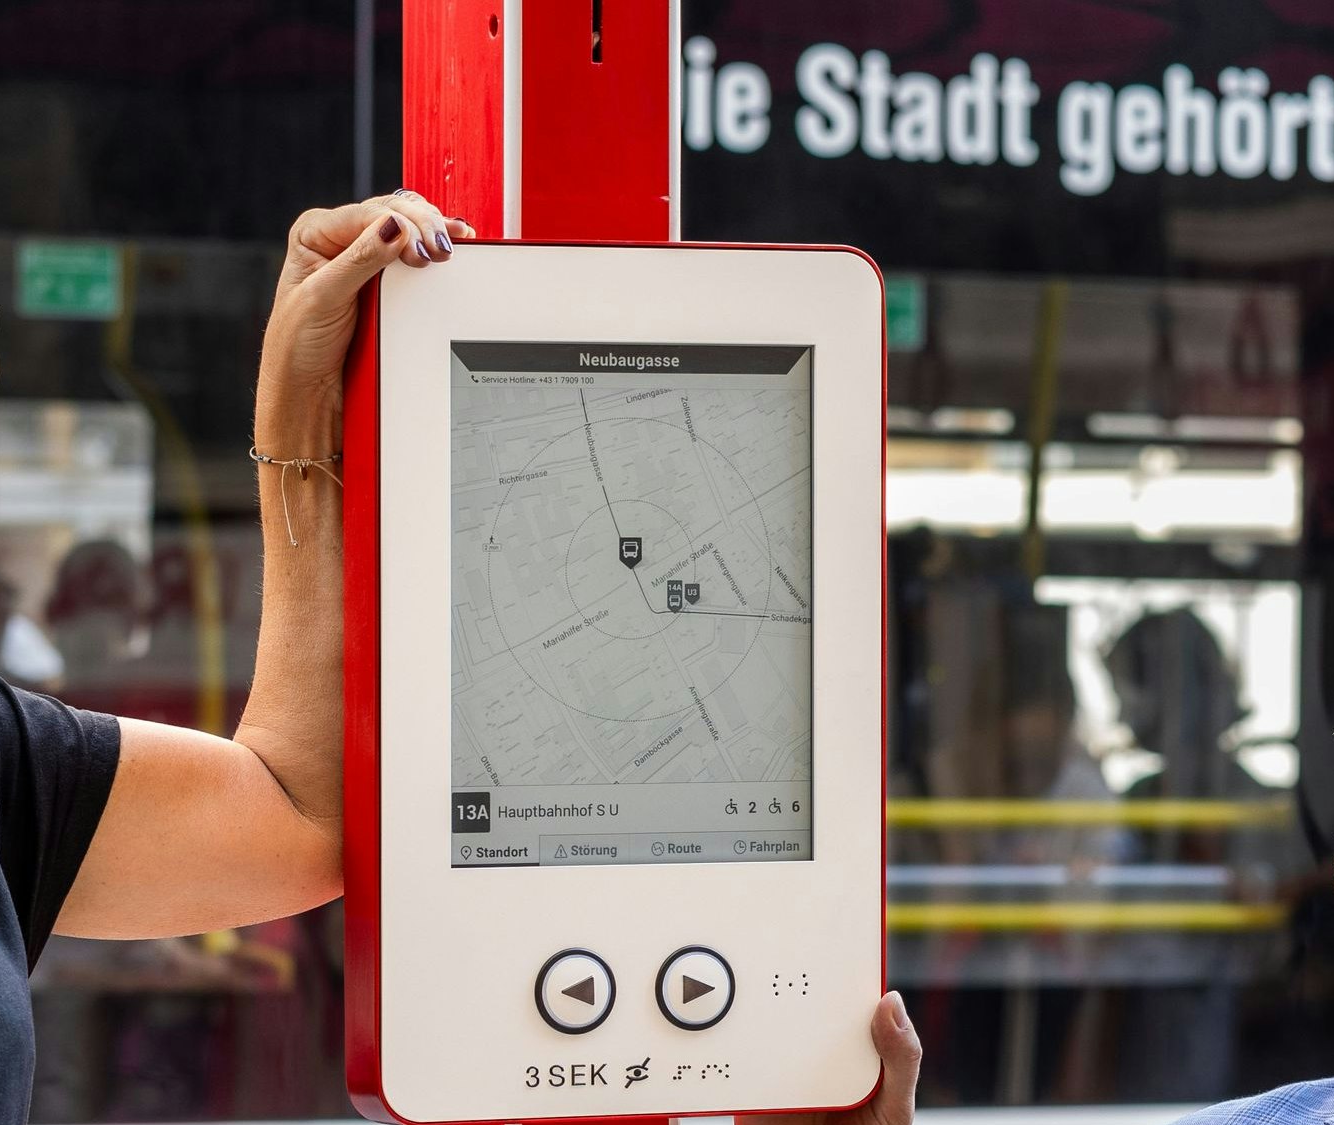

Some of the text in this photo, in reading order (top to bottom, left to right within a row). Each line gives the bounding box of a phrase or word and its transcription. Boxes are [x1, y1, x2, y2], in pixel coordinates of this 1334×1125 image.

[681, 35, 771, 154] ie
[794, 42, 1041, 167] Stadt
[579, 352, 680, 370] Neubaugasse
[481, 375, 508, 384] Service
[509, 376, 537, 384] Hotline:
[539, 376, 552, 384] +43
[560, 377, 578, 385] 7909
[581, 377, 594, 385] 100
[681, 396, 697, 443] Zollergasse
[584, 423, 604, 482] Neubaugasse
[499, 469, 548, 485] Richtergasse
[689, 541, 714, 562] Straße
[687, 588, 698, 596] U3
[774, 566, 808, 609] Nelkengasse
[542, 607, 610, 649] Mariahilfer Straße
[688, 686, 720, 742] Amerlingstraße
[457, 803, 619, 821] 13A Hauptbahnhof S U
[748, 800, 800, 813] 2 6
[476, 846, 528, 858] Standort
[570, 844, 618, 858] Störung
[667, 843, 702, 854] Route
[749, 840, 800, 855] Fahrplan
[525, 1063, 608, 1088] 3 SEK
